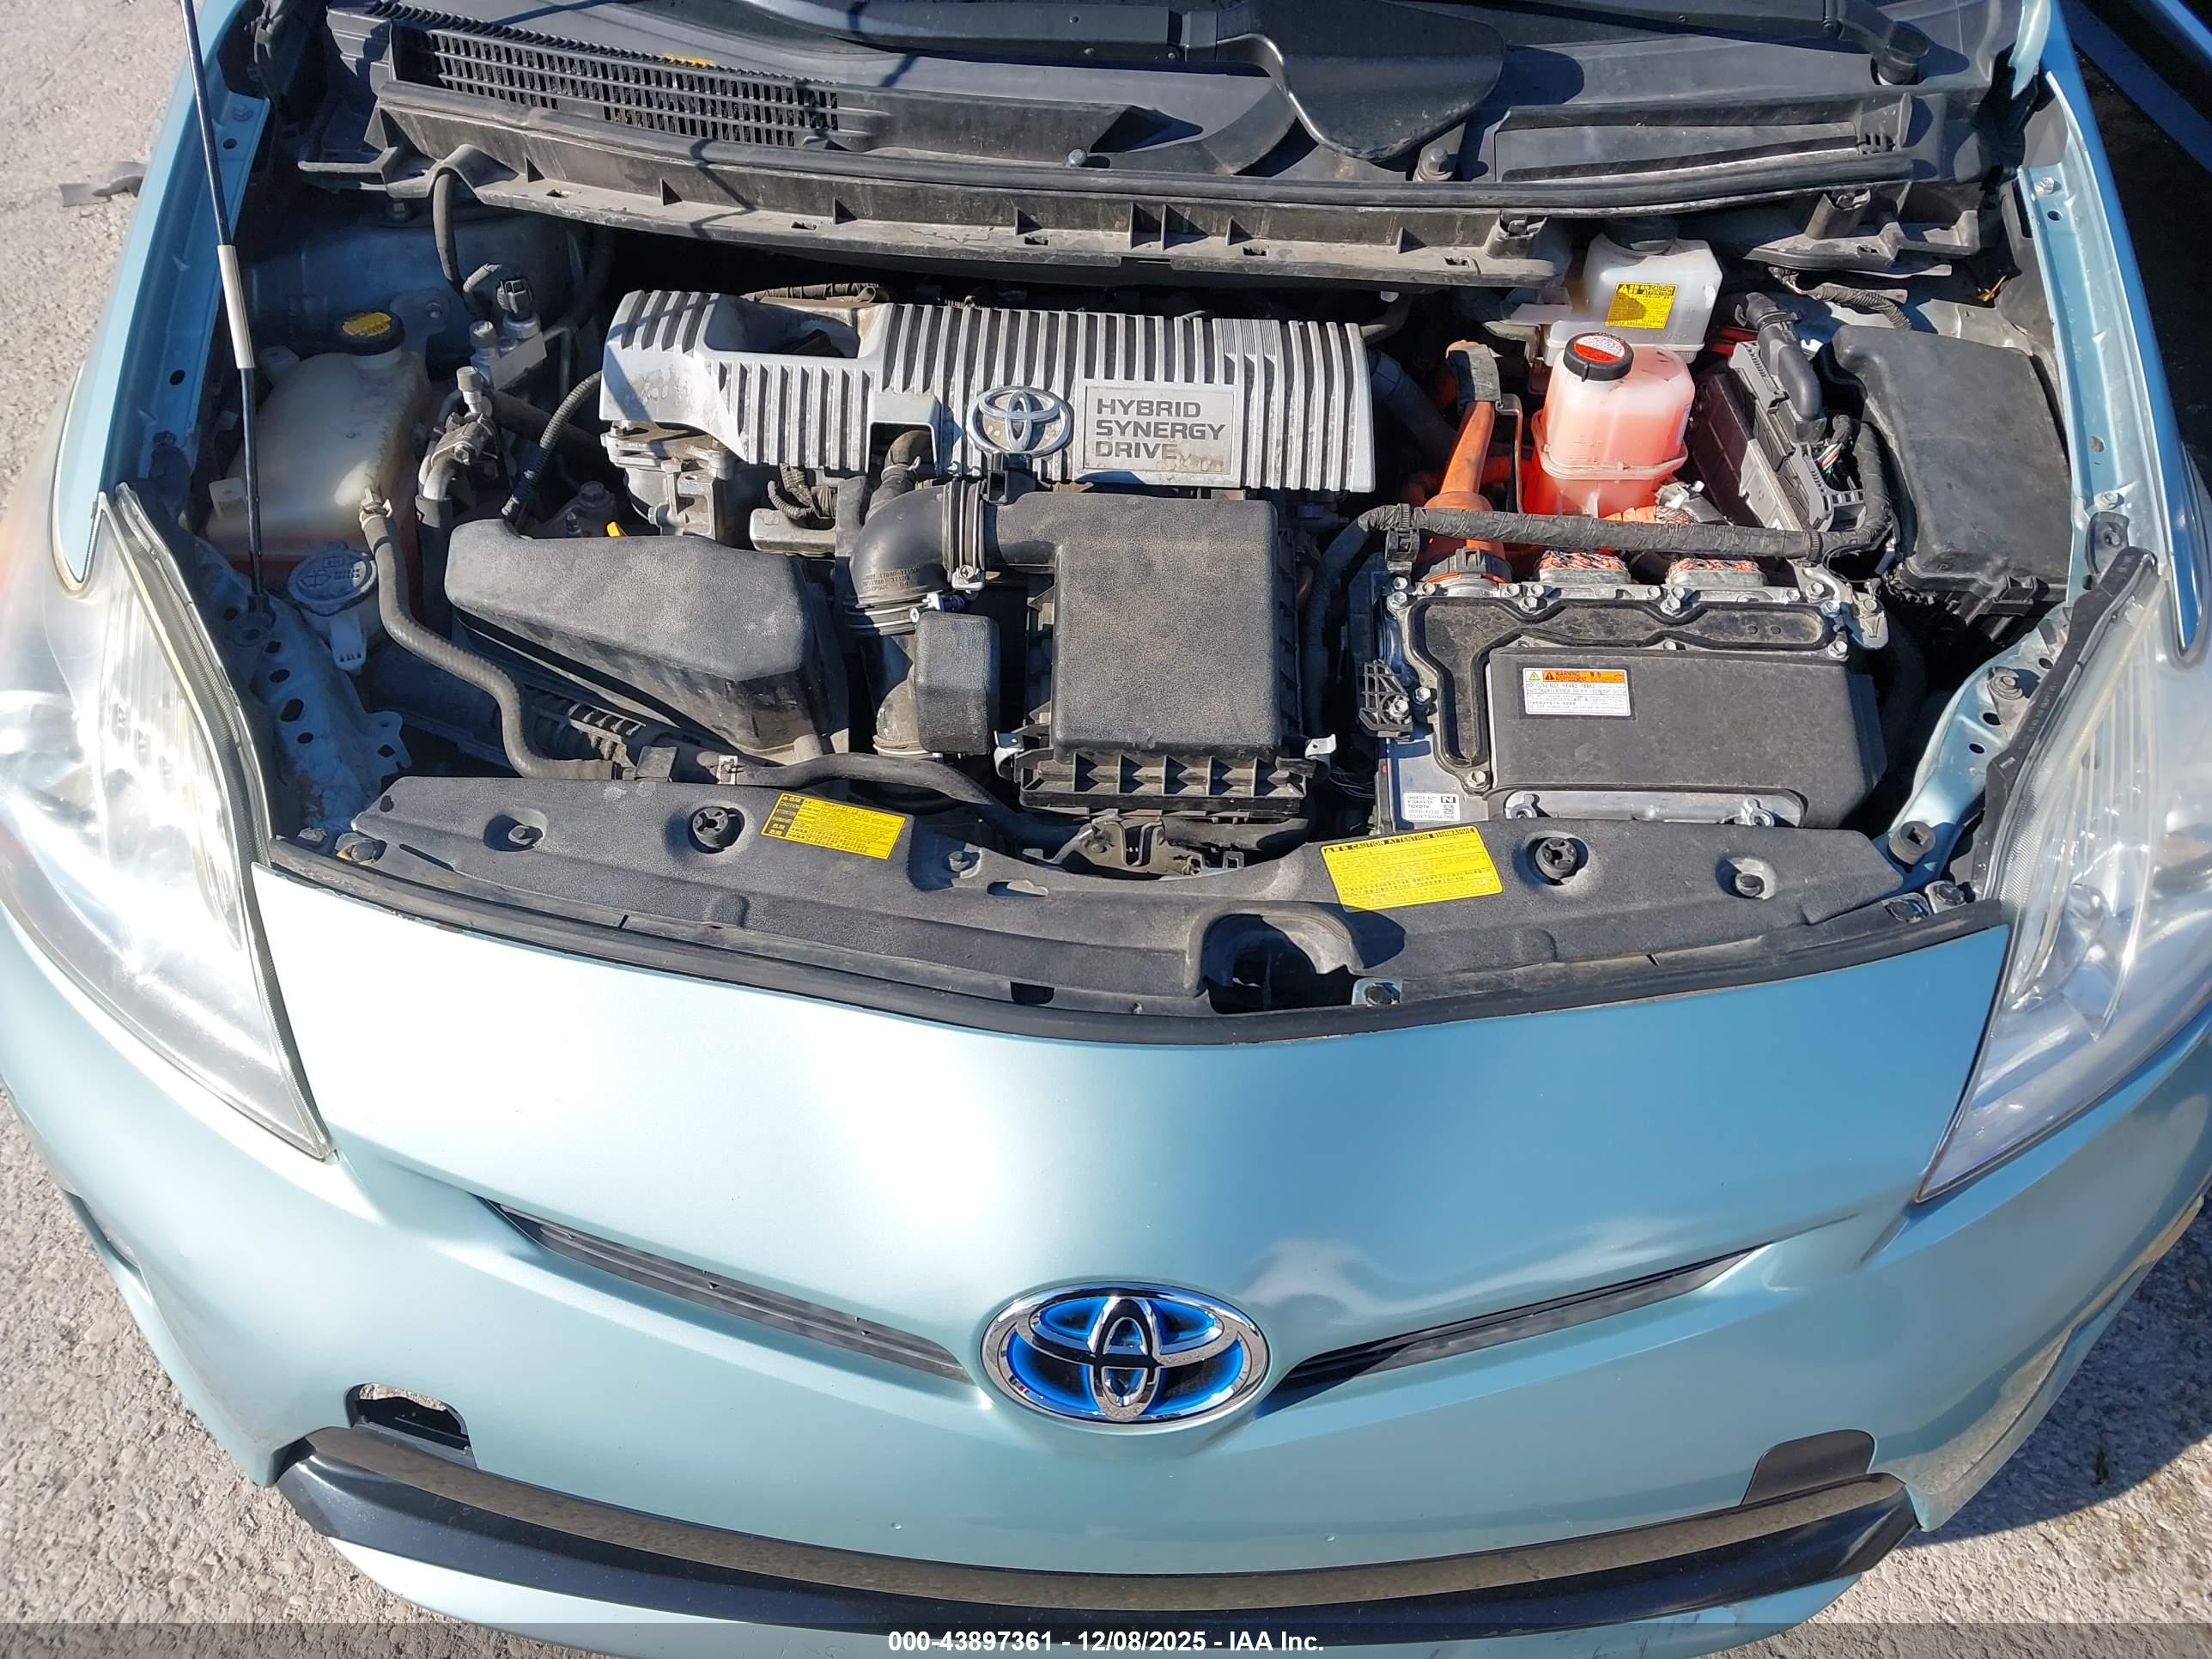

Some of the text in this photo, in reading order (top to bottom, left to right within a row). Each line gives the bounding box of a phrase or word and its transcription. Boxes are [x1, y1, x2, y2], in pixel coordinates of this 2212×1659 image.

[1097, 398, 1200, 417] HYBRID
[1096, 420, 1225, 440] SYNERGY
[1095, 441, 1177, 459] DRIVE
[1352, 840, 1384, 850] CAUTION
[1389, 833, 1430, 845] ATTENTION
